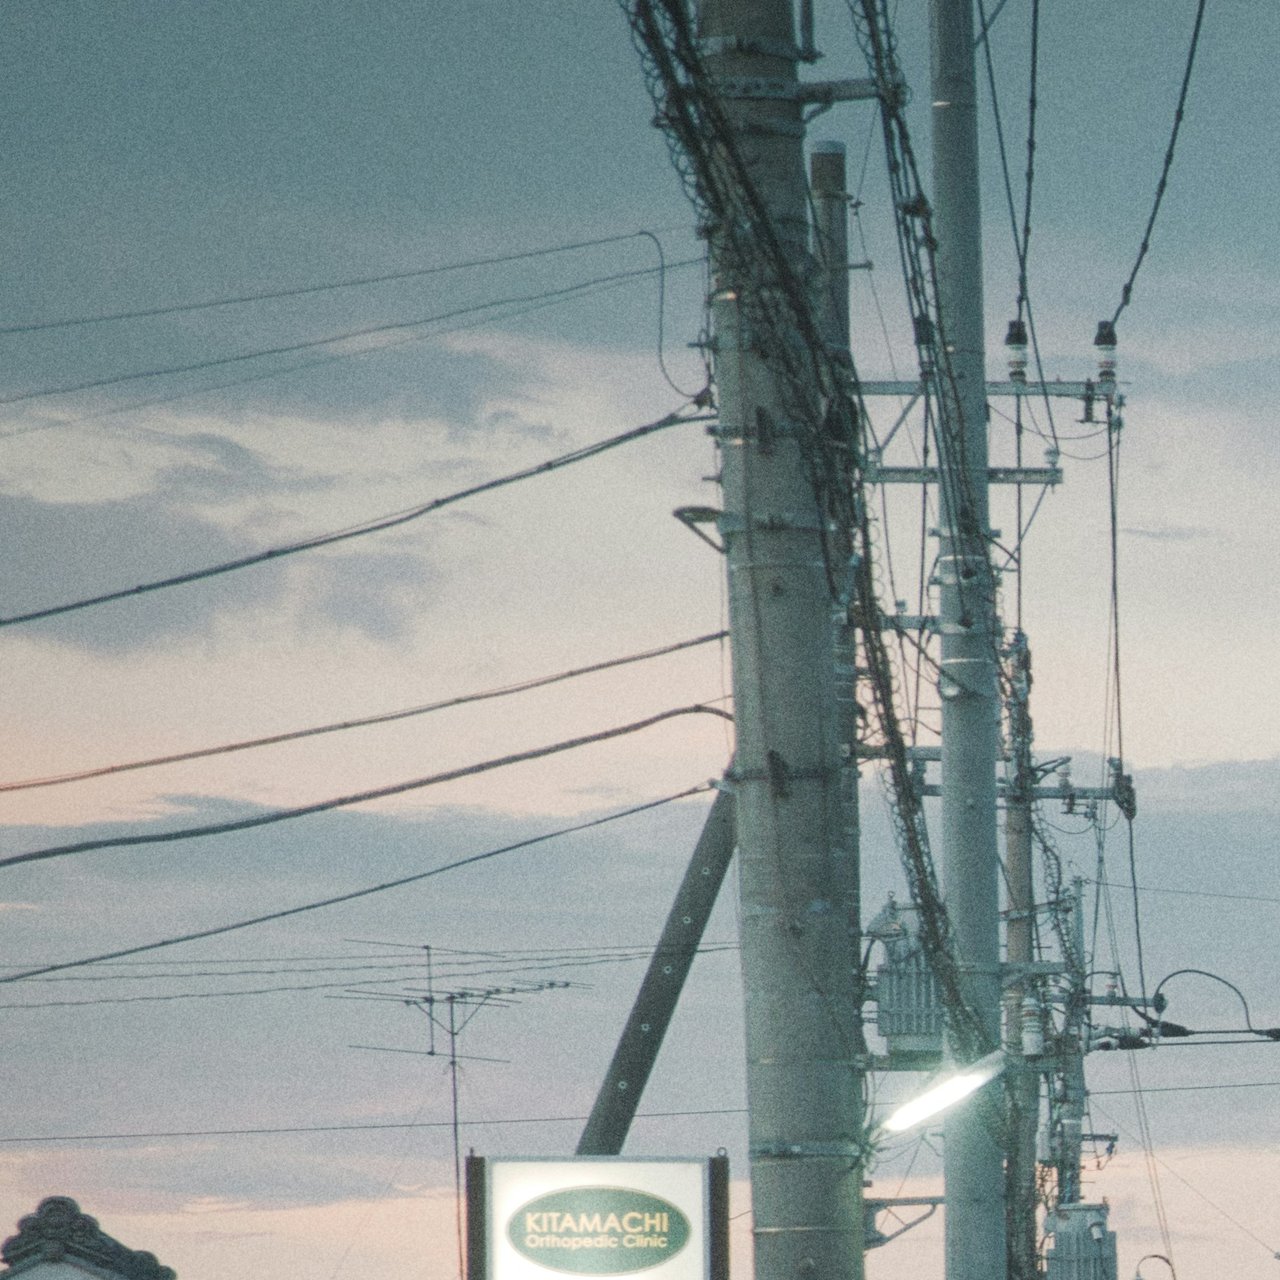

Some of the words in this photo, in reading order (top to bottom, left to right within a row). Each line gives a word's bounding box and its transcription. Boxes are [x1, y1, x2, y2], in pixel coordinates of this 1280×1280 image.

[525, 1212, 669, 1234] KITAMACHI
[525, 1234, 618, 1250] Orthopedic
[623, 1233, 668, 1248] Clinic
